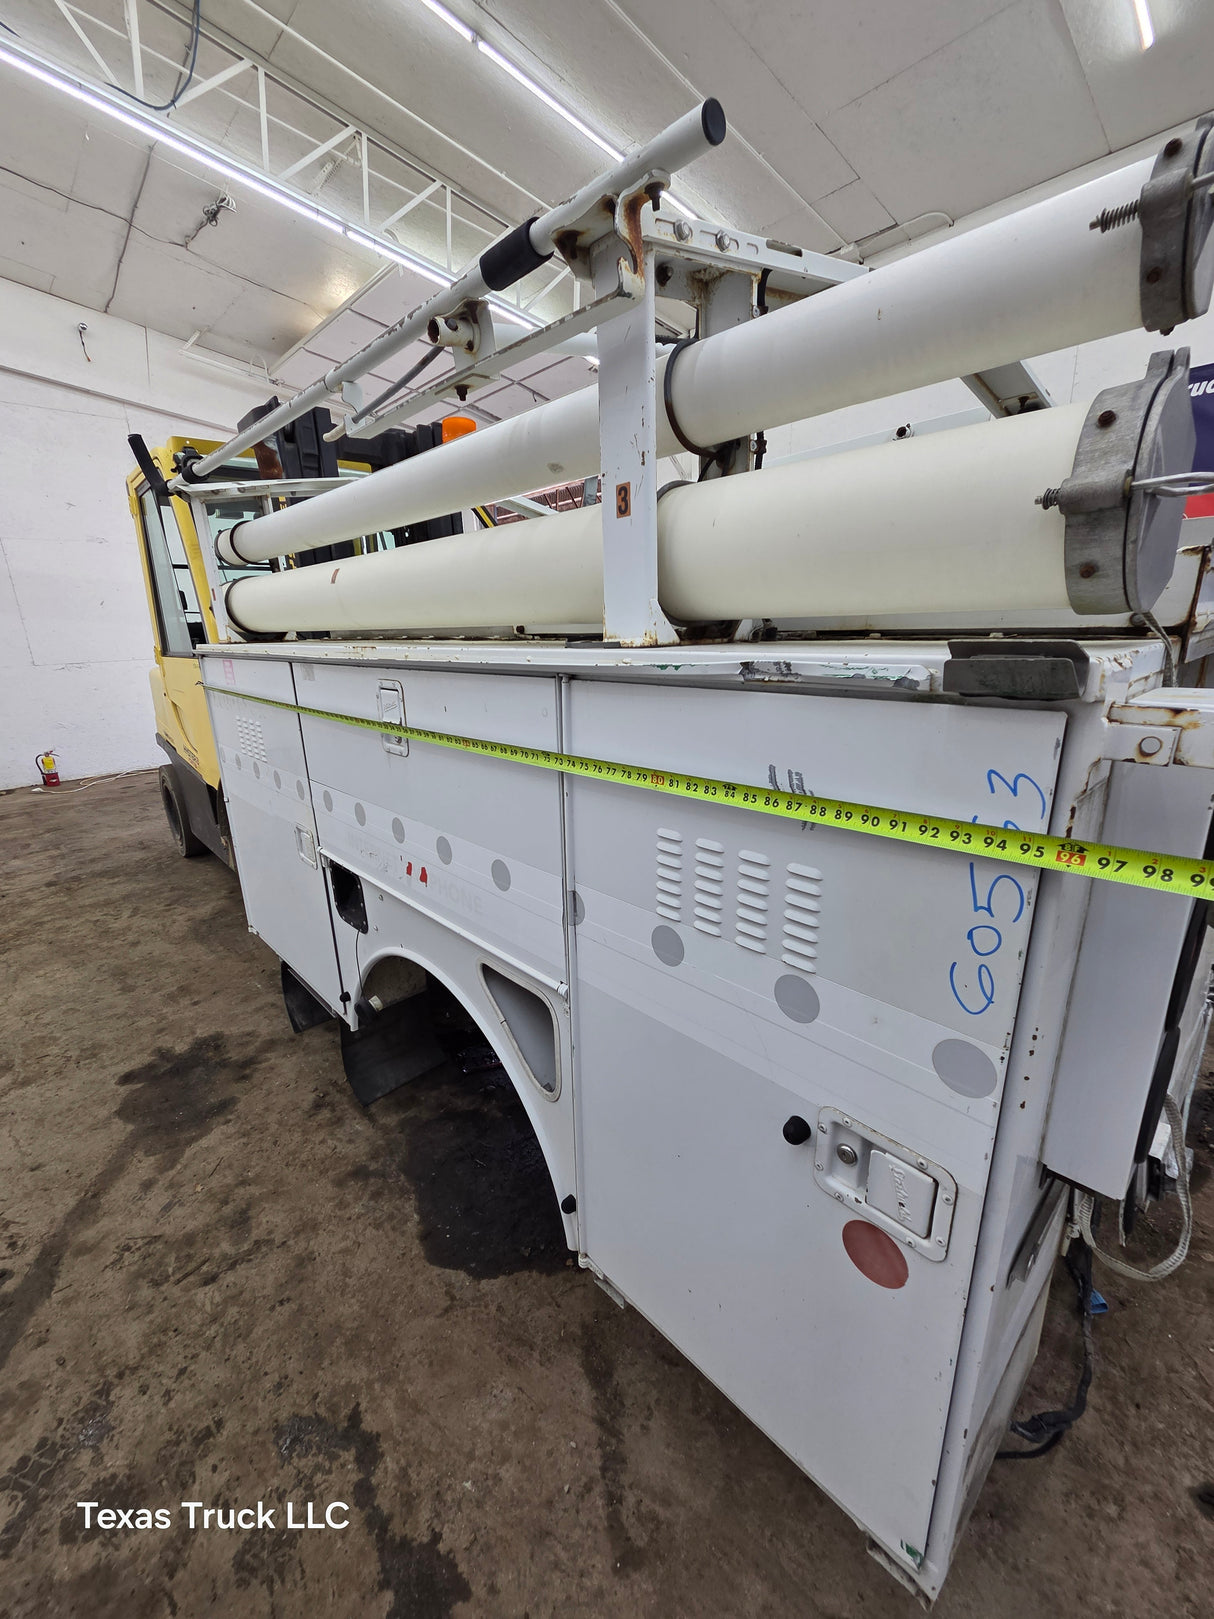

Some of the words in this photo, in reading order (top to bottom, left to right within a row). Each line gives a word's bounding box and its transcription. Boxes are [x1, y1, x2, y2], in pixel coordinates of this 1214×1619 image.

[618, 486, 628, 515] 3
[520, 750, 529, 759] 70
[530, 752, 539, 760] 71
[554, 756, 563, 765] 73
[566, 759, 576, 767] 74
[579, 761, 589, 770] 75
[593, 763, 602, 773] 76
[606, 766, 617, 775] 77
[621, 769, 632, 779] 78
[636, 772, 648, 782] 79
[668, 778, 679, 788] 81
[686, 781, 698, 792] 82
[704, 785, 717, 796] 83
[724, 790, 735, 798] 84
[743, 792, 757, 803] 85
[764, 796, 779, 808] 86
[786, 800, 803, 811] 87
[810, 804, 827, 817] 88
[834, 809, 853, 821] 89
[861, 814, 880, 827] 90
[889, 819, 907, 832] 91
[919, 824, 940, 838] 92
[950, 830, 972, 844] 93
[984, 836, 1007, 851] 94
[1020, 843, 1045, 858] 95
[1060, 852, 1081, 865] 96
[1097, 857, 1128, 872] 97
[1142, 865, 1174, 882] 98
[950, 769, 1046, 1015] 6053
